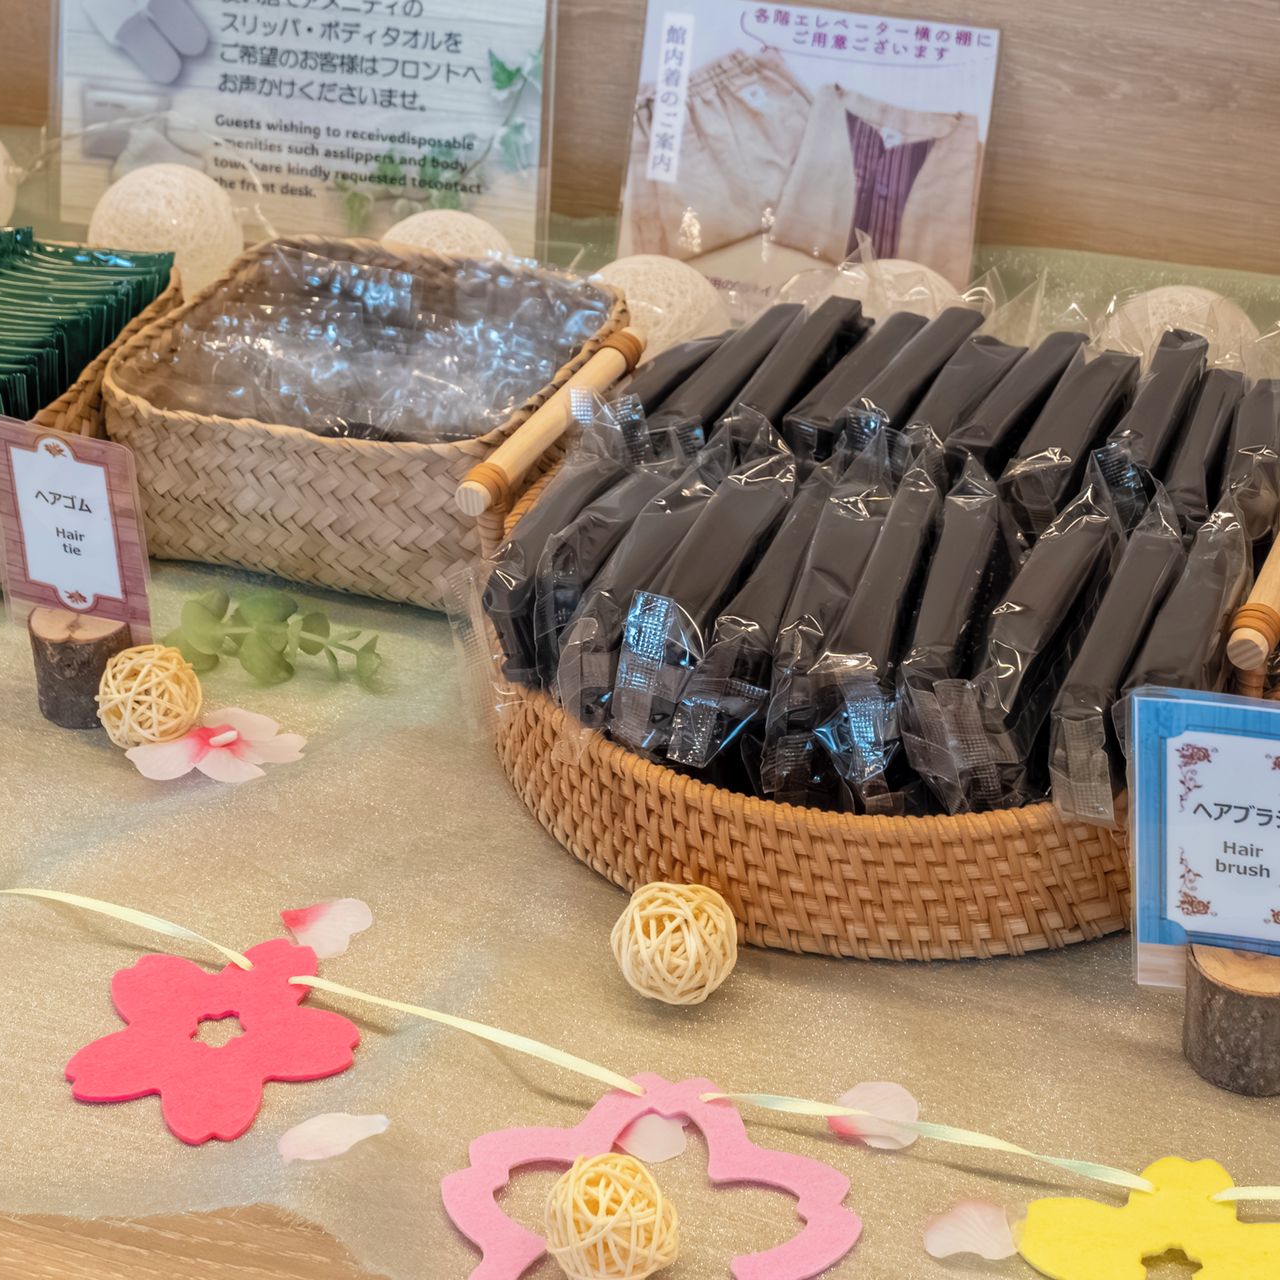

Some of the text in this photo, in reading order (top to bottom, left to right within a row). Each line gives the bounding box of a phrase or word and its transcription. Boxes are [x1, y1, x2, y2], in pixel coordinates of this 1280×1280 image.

[221, 12, 463, 54] スリッパ・ボディタオルを
[793, 30, 949, 60] ご用意ございます
[219, 42, 483, 84] ご希望のお客様はフロントへ
[218, 72, 426, 112] お声かけくださいませ。
[651, 24, 687, 173] 館内着のご案内
[215, 114, 261, 131] Guests
[266, 120, 322, 139] wishing
[326, 126, 341, 138] to
[288, 143, 319, 157] such
[399, 154, 427, 168] and
[431, 155, 468, 175] body
[287, 162, 330, 181] kindly
[335, 170, 407, 187] requested
[281, 183, 317, 198] desk.
[35, 489, 93, 514] ヘアゴム
[55, 526, 85, 542] Hair
[62, 543, 82, 556] tie
[1223, 840, 1263, 858] Hair
[1215, 858, 1270, 878] brush
